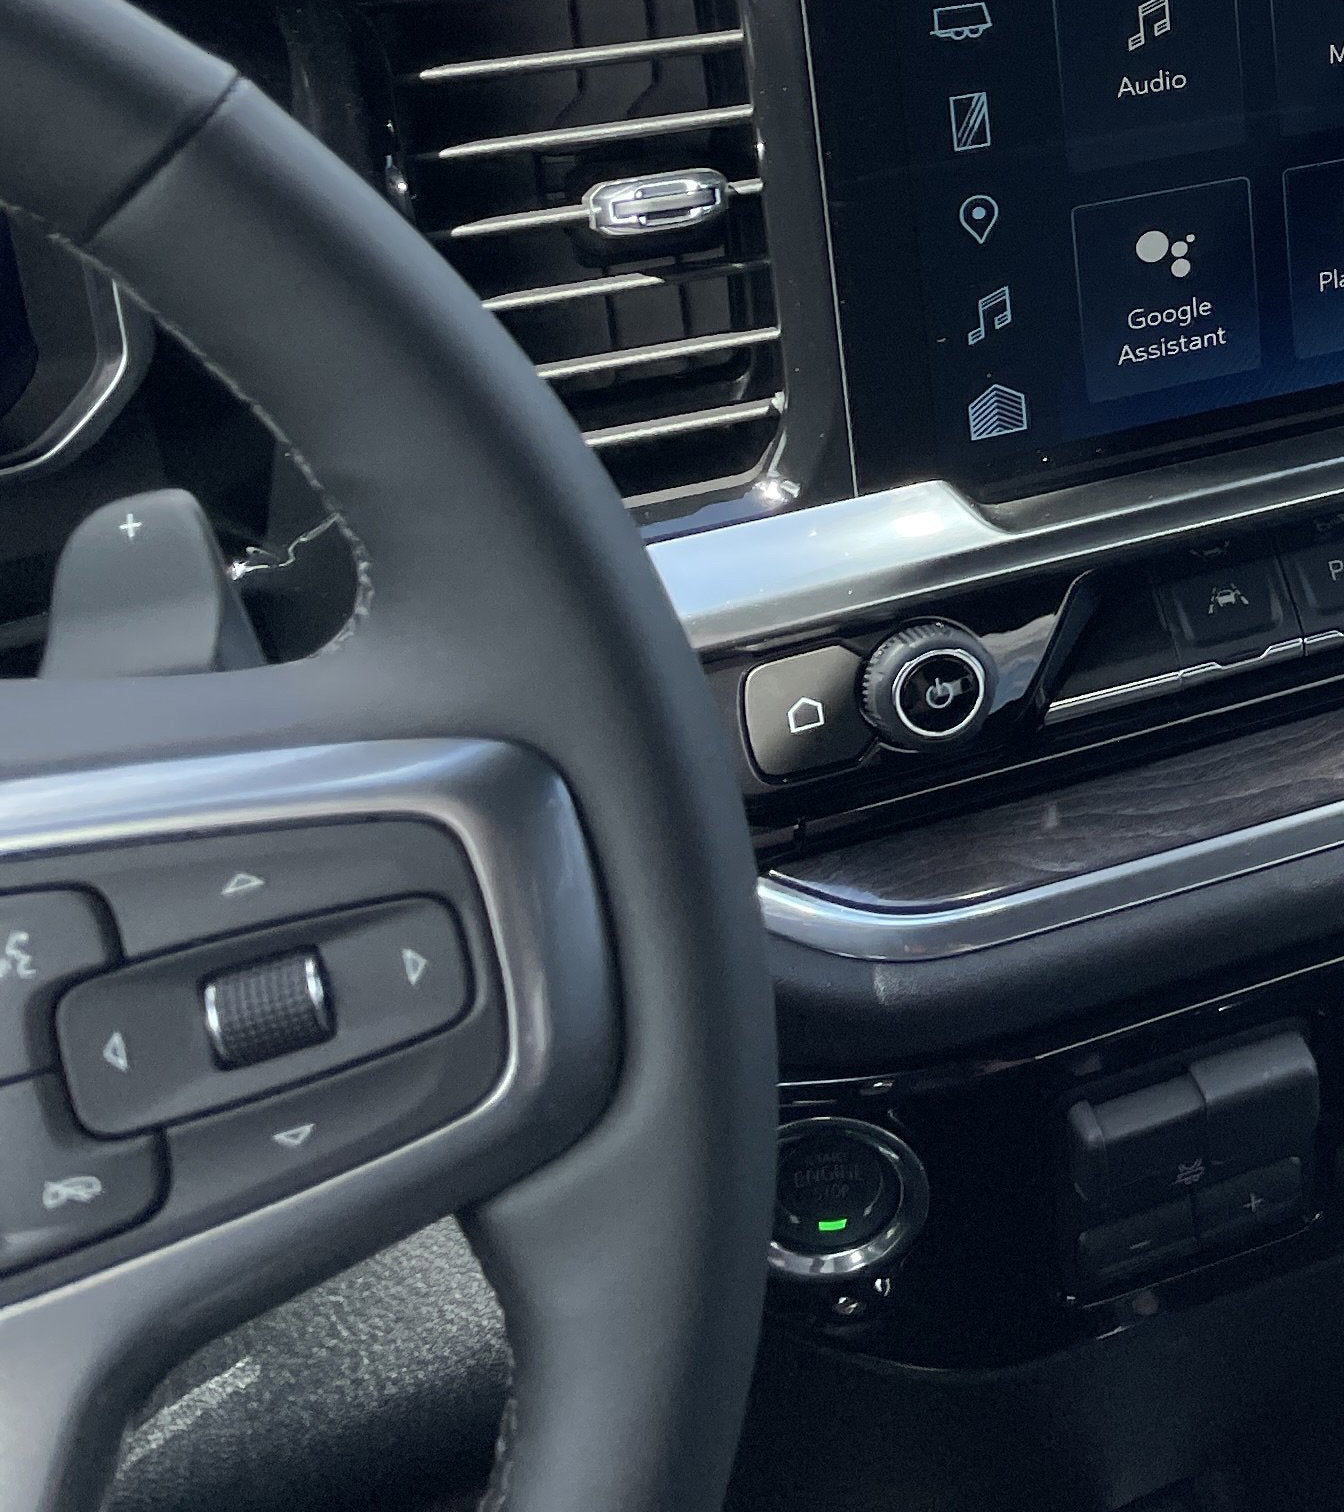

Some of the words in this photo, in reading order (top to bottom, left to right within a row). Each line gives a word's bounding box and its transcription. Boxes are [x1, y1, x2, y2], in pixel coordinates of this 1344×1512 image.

[1116, 68, 1188, 100] Audio
[1126, 297, 1213, 333] Google
[1117, 326, 1228, 366] Assistant
